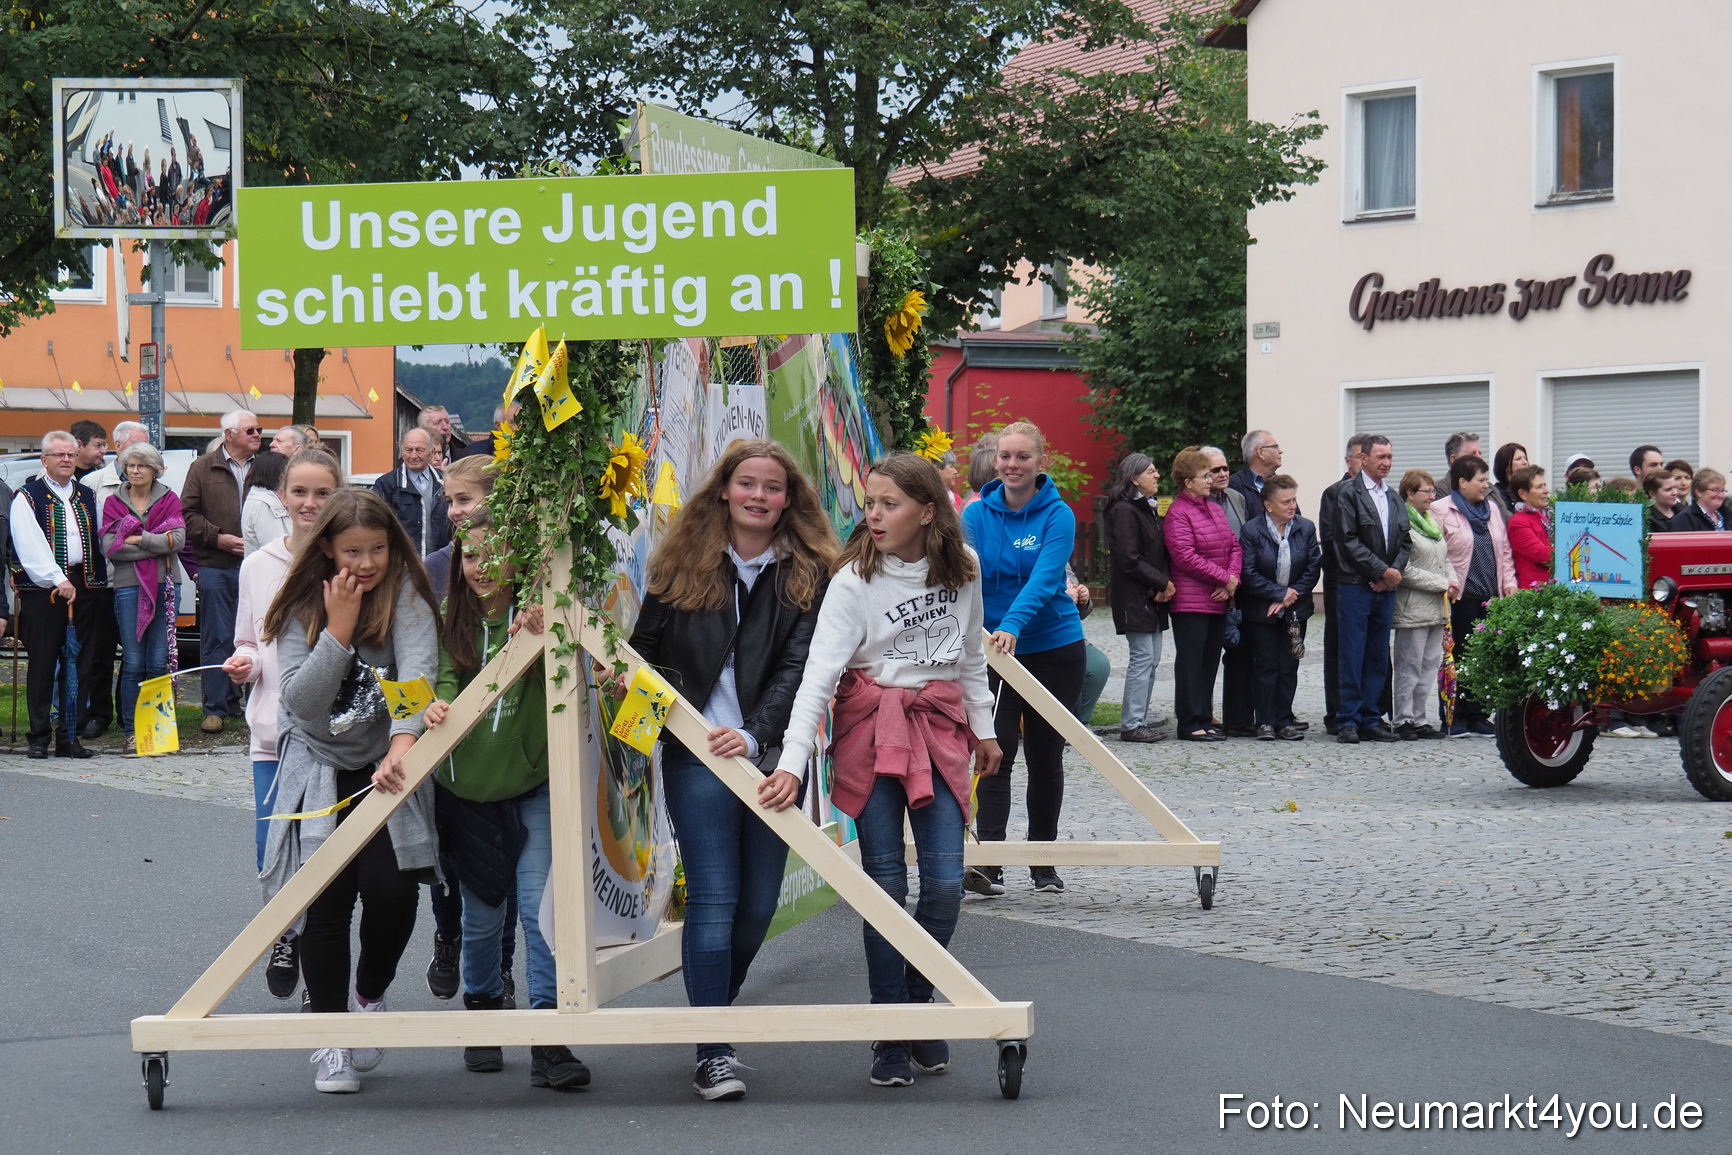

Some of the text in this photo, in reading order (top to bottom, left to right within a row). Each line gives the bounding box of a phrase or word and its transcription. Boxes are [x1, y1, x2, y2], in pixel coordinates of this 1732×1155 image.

[301, 185, 777, 254] Unsere Jugend
[256, 258, 842, 327] schiebt kräftig an !
[1349, 253, 1692, 332] Gasthaus zur Sonne
[885, 589, 958, 624] LET'S GO
[903, 605, 947, 628] REVIEW
[893, 614, 962, 660] 92
